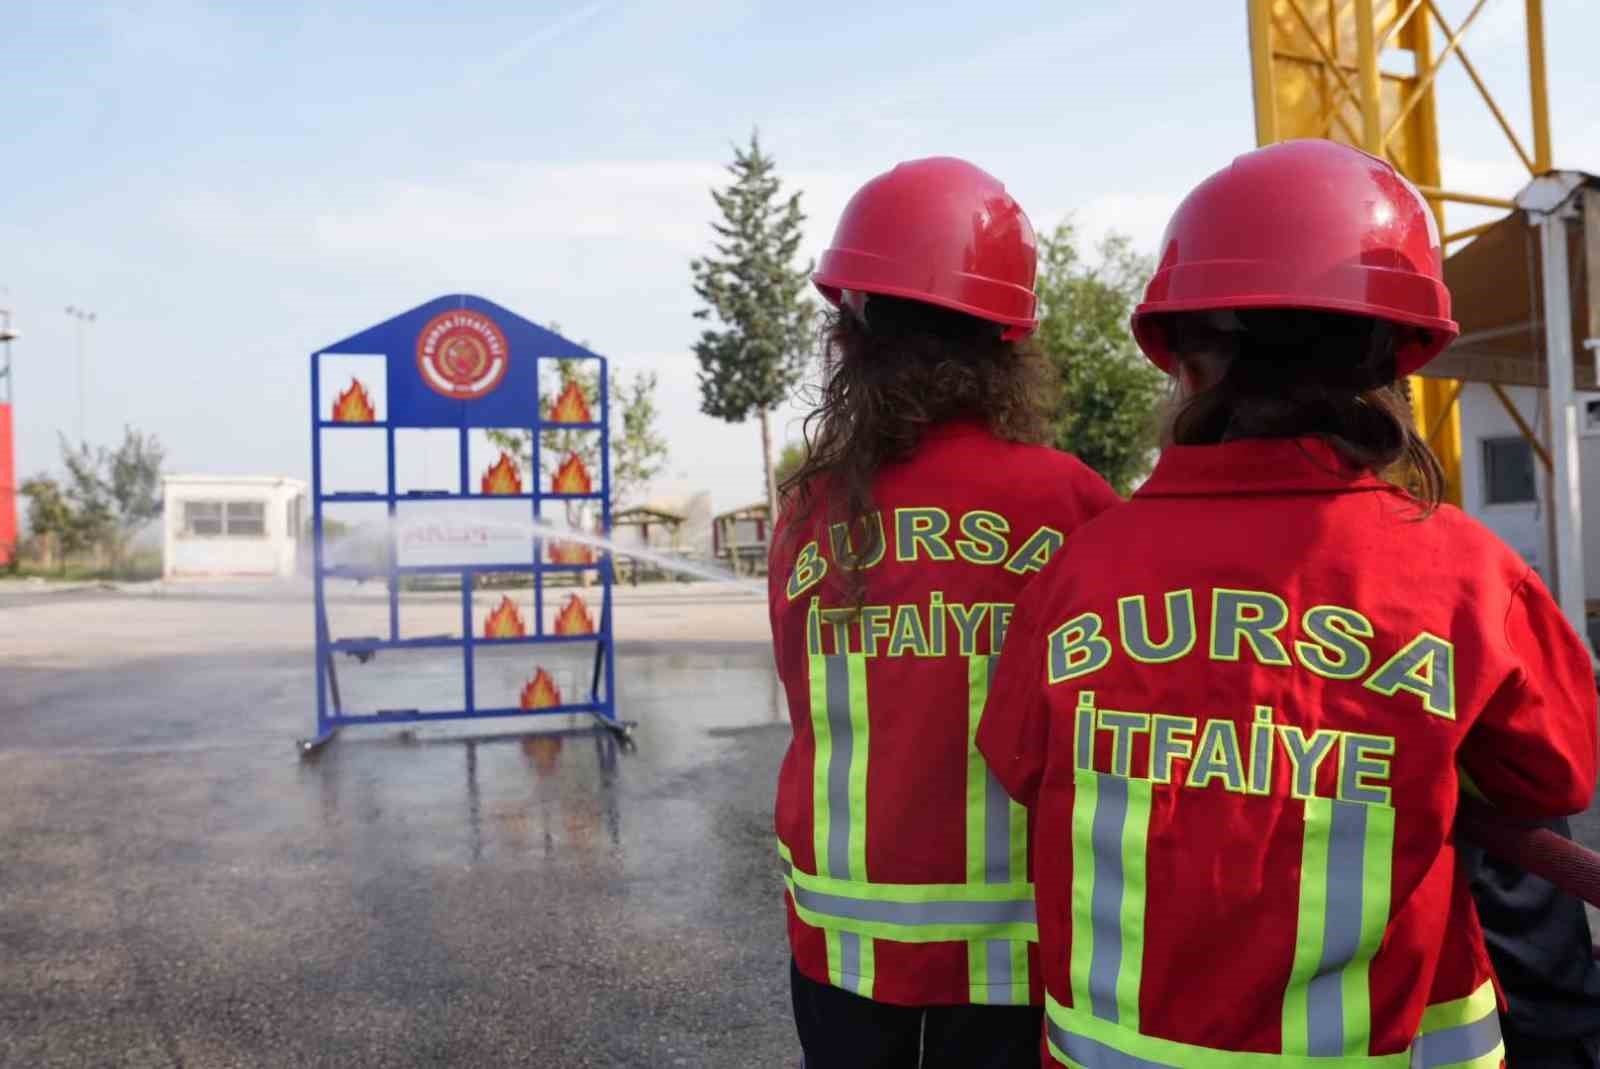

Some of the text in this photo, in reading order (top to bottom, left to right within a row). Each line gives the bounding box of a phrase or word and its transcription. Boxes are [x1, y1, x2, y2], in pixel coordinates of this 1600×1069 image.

[786, 506, 1064, 601] BURSA
[1047, 588, 1456, 721] BURSA
[1073, 690, 1396, 808] İTFAİYE
